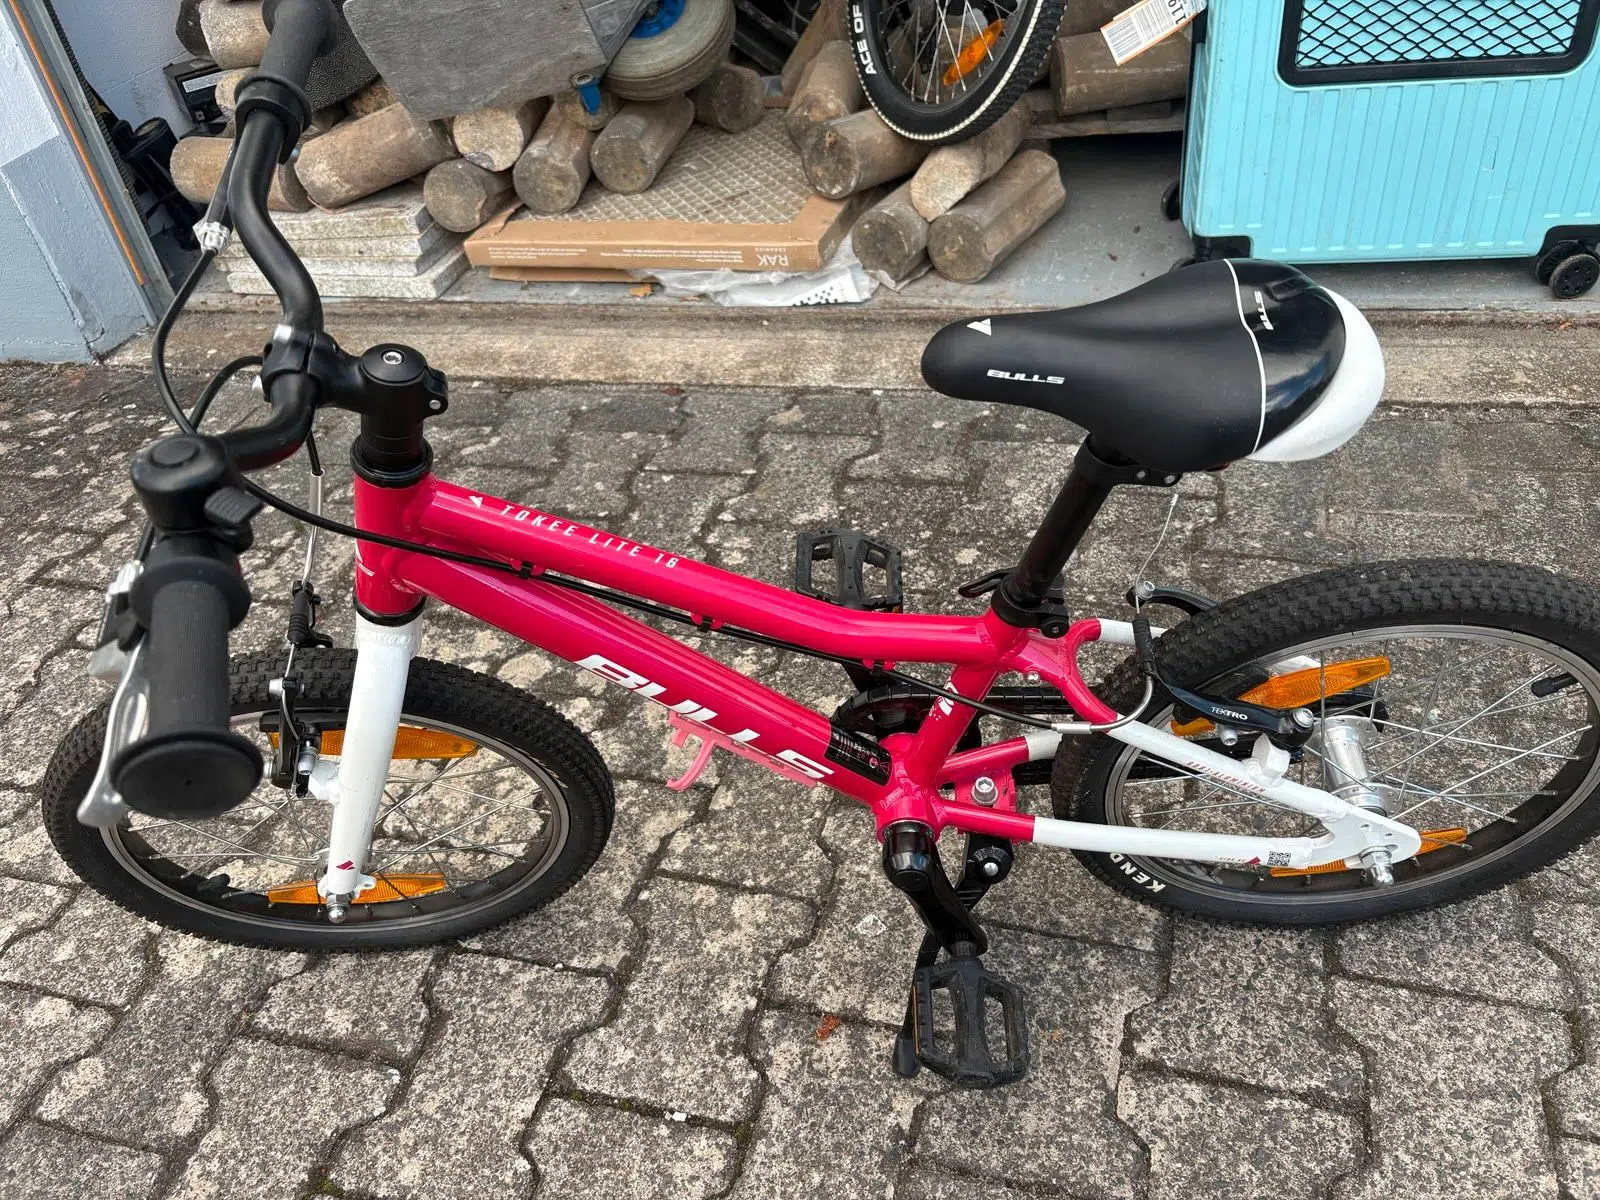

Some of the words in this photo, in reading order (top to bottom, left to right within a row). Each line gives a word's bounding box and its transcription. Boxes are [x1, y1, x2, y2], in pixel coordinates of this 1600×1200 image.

[853, 5, 865, 34] OF
[857, 38, 877, 75] ACE
[756, 254, 789, 266] RAK
[986, 369, 1065, 385] BULLS
[500, 505, 578, 537] TOKEE
[588, 532, 644, 558] LITE
[654, 553, 680, 569] 16
[1211, 705, 1249, 721] TEKTRO
